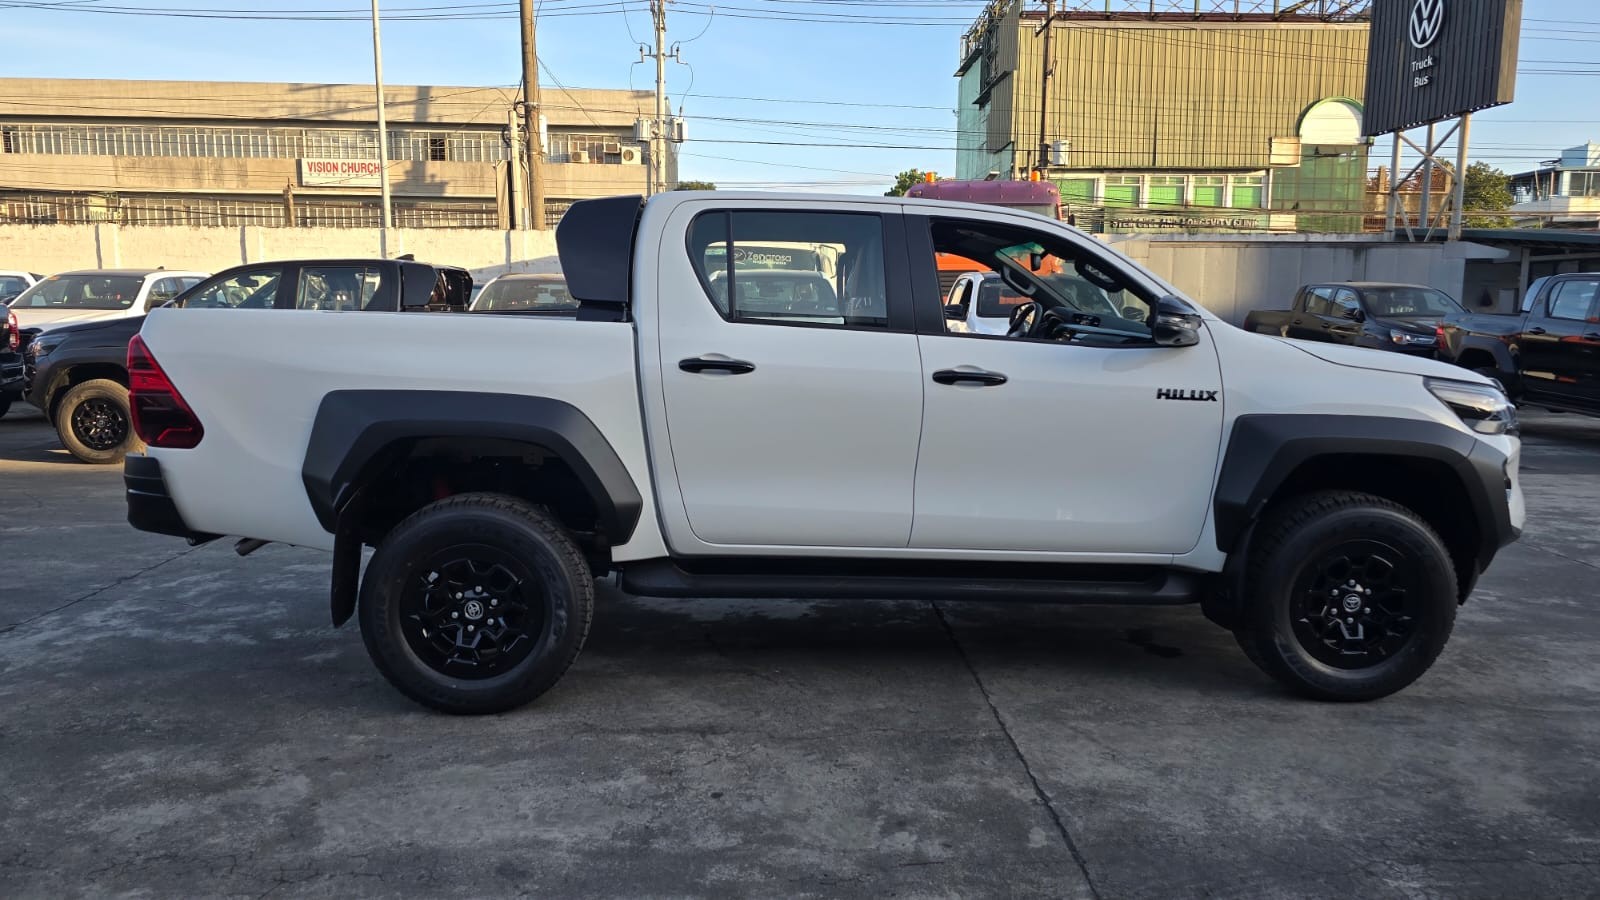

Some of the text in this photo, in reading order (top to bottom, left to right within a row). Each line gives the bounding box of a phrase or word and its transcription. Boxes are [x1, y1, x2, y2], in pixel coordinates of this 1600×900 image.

[1412, 55, 1433, 72] Truck
[1414, 76, 1430, 87] Bus
[307, 162, 380, 173] VISION CHURCH
[747, 251, 791, 262] Zenarosa
[1156, 388, 1218, 402] HILUX
